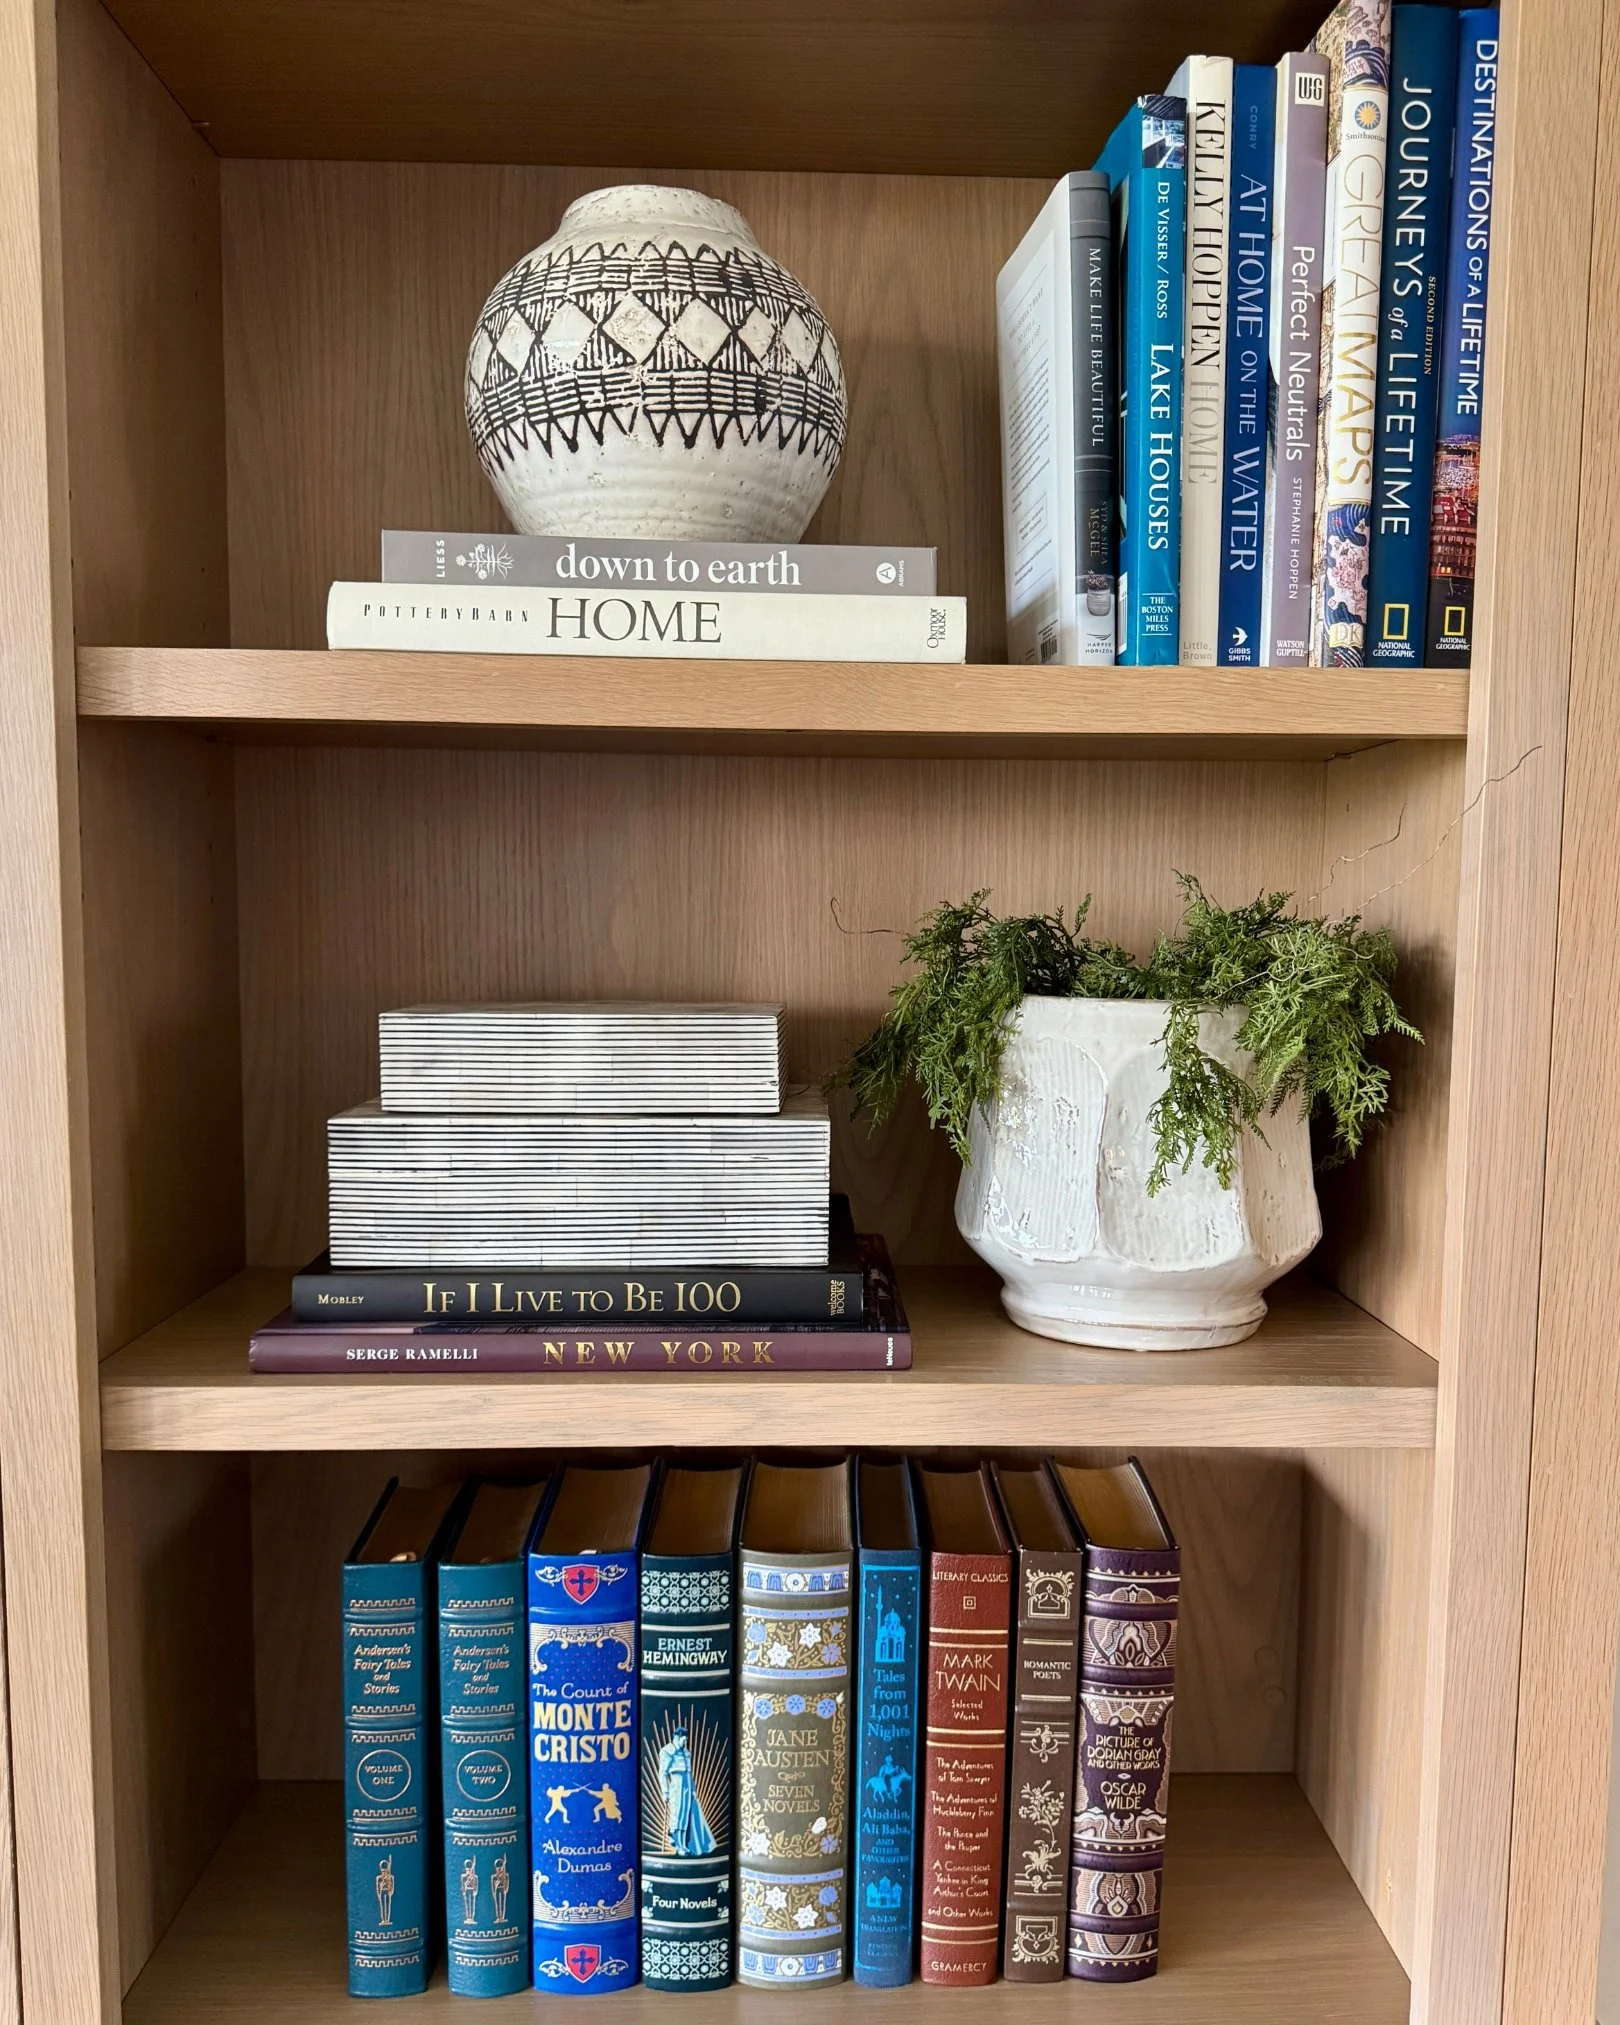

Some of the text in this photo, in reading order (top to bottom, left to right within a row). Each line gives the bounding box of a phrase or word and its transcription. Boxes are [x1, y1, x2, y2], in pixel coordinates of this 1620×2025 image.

[1248, 105, 1258, 150] CONRY
[1456, 40, 1498, 415] DESTINATIONS OF A LIFETIME
[1188, 99, 1227, 485] KELLY HOPPEN HOME
[1381, 78, 1432, 535] JOURNEYS of a LIFETIME
[1423, 275, 1436, 376] SECOND EDITION
[1089, 247, 1104, 447] MAKE LIFE BEAUTIFUL
[1229, 174, 1267, 571] AT HOME ON THE WATER
[1150, 343, 1174, 420] LAKE
[1286, 246, 1315, 600] Perfect Neutrals STEPHANIE HOPPEN
[1148, 432, 1173, 550] HOUSES
[436, 539, 445, 578] LIESS
[556, 543, 802, 586] down to earth
[1150, 596, 1166, 605] THE
[1141, 605, 1173, 614] BOSTON
[546, 597, 722, 643] HOME
[1145, 614, 1169, 623] MILLS
[927, 607, 940, 648] Oxmoor
[1145, 623, 1169, 632] PRESS
[1228, 647, 1251, 655] GIBBS
[1276, 640, 1305, 648] WATSON
[1378, 641, 1412, 650] NATIONAL
[1435, 643, 1470, 651] GEOGRAPHIC
[1183, 651, 1212, 660] Brown
[1372, 649, 1416, 658] GEOGRAPHIC
[466, 1282, 480, 1313] I
[830, 1279, 838, 1316] welcome
[836, 1280, 846, 1315] BOOKS
[346, 1348, 479, 1361] SERGE RAMELLI
[542, 1341, 776, 1365] NEW YORK
[932, 1570, 1009, 1583] LITERARY CLASSICS
[354, 1644, 412, 1656] Andersen's
[453, 1644, 510, 1656] Andersen's
[657, 1637, 713, 1651] ERNEST
[643, 1649, 728, 1665] HEMINGWAY
[943, 1653, 994, 1669] MARK
[354, 1658, 412, 1672] Fairy Tales
[453, 1658, 510, 1672] Fairy Tales
[1024, 1660, 1072, 1670] ROMANTIC
[373, 1672, 391, 1681] and
[472, 1672, 490, 1682] and
[873, 1670, 906, 1683] Tales
[935, 1670, 1001, 1692] TWAIN
[1033, 1670, 1062, 1680] POETS
[363, 1683, 400, 1695] Stories
[463, 1683, 500, 1695] Stories
[532, 1681, 630, 1699] The Count of
[874, 1685, 906, 1700] from
[952, 1698, 983, 1709] Selected
[533, 1699, 632, 1732] MONTE
[869, 1703, 910, 1722] 1,001
[954, 1710, 980, 1721] Works
[766, 1728, 818, 1747] JANE
[867, 1722, 911, 1742] Nights
[1118, 1726, 1135, 1736] THE
[534, 1731, 631, 1763] CRISTO
[1095, 1734, 1155, 1749] PICTURE OF
[753, 1748, 831, 1768] AUSTEN
[1087, 1745, 1162, 1761] DORIAN GRAY
[365, 1764, 403, 1774] VOLUME
[464, 1764, 503, 1774] VOLUME
[936, 1757, 994, 1770] The Adventures
[1087, 1758, 1160, 1770] AND OTHER WORKS
[372, 1776, 395, 1785] ONE
[472, 1776, 496, 1785] TWO
[949, 1771, 964, 1782] Tom
[768, 1784, 815, 1798] SEVEN
[1100, 1780, 1146, 1796] OSCAR
[931, 1790, 988, 1804] The Adventures
[1104, 1795, 1142, 1810] WILDE
[762, 1798, 821, 1814] NOVELS
[978, 1805, 995, 1817] Finn
[862, 1822, 880, 1835] Ali
[937, 1825, 951, 1838] The
[975, 1827, 989, 1838] and
[542, 1839, 623, 1856] Alexandre
[557, 1857, 612, 1874] Dumas
[932, 1859, 991, 1872] A Connecticut
[970, 1874, 989, 1886] King
[965, 1886, 989, 1897] Court
[652, 1894, 718, 1910] Four Novels
[927, 1905, 993, 1917] and Other Works
[930, 1960, 987, 1973] GRAMERCY
